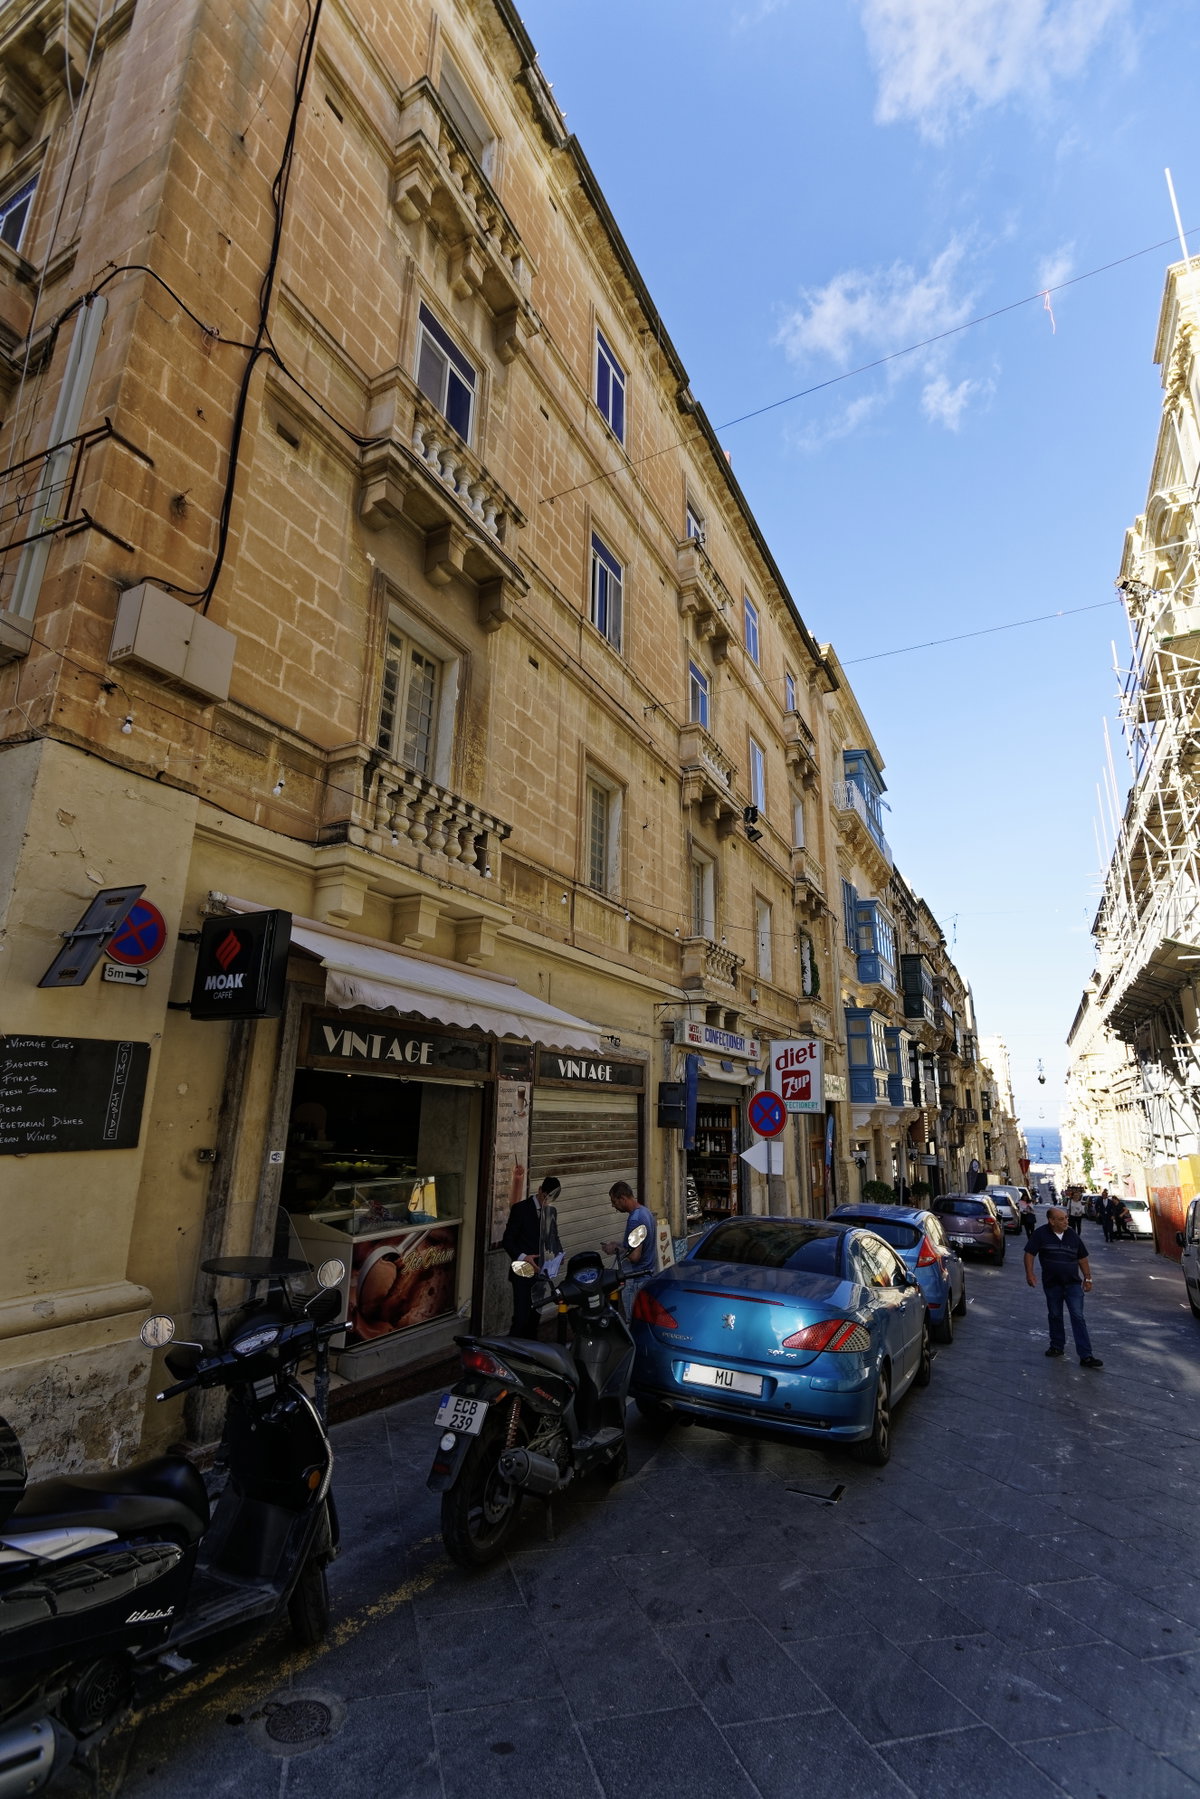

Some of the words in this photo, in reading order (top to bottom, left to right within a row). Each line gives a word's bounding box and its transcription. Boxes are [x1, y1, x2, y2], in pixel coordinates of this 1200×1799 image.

[107, 967, 124, 979] 5m
[204, 973, 244, 991] MOAK
[322, 1025, 435, 1065] VINTAGE
[704, 1027, 746, 1052] CONFECTIONERY
[116, 1043, 130, 1085] COME
[775, 1042, 817, 1071] diet
[557, 1059, 613, 1082] VINTAGE
[783, 1074, 810, 1099] 7UP
[785, 1101, 819, 1110] FECTIONERY
[0, 1118, 46, 1130] EGETARIAN
[0, 1133, 19, 1144] EGAN
[402, 1250, 421, 1274] Ice
[423, 1246, 456, 1270] Cream
[714, 1369, 734, 1387] MU
[453, 1398, 478, 1416] ECB
[449, 1414, 473, 1431] 239
